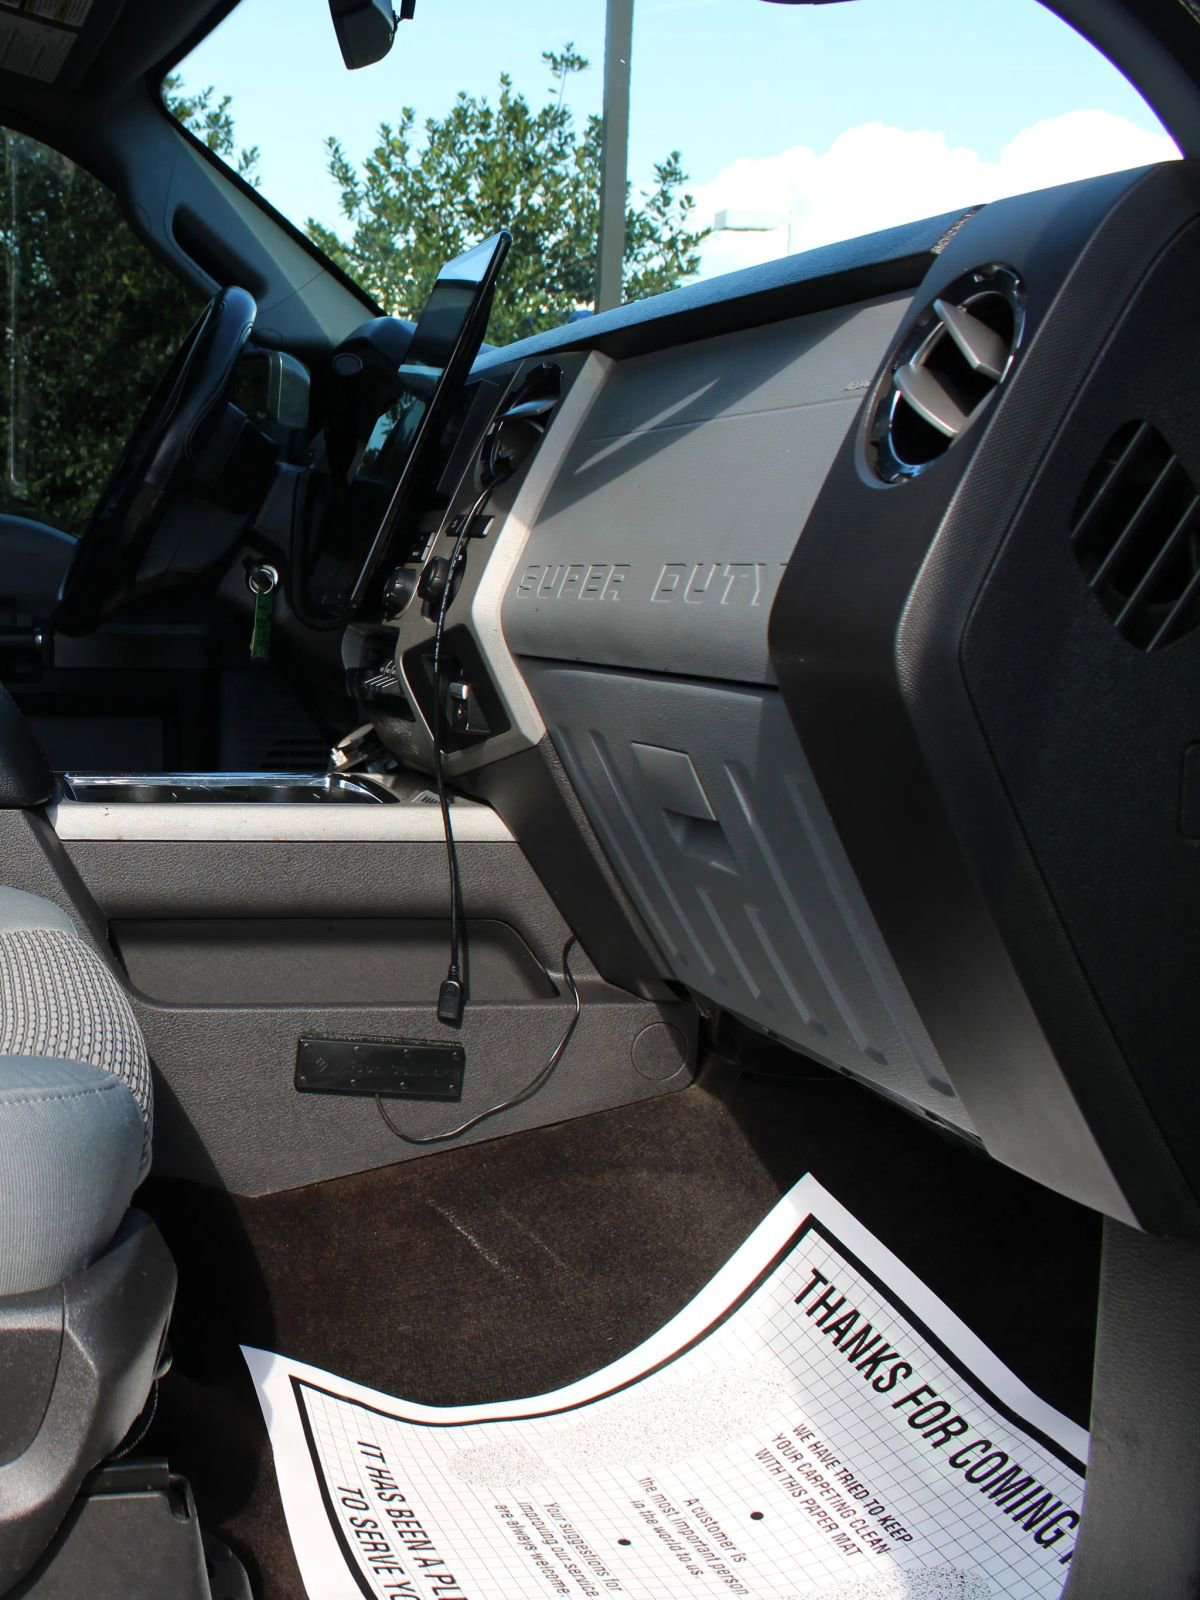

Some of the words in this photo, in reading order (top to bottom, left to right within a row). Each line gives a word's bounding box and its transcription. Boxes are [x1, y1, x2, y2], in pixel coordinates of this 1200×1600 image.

[516, 563, 632, 601] SUPER
[650, 562, 788, 607] DUTY
[794, 1267, 913, 1394] THANKS
[892, 1384, 969, 1450] FOR
[948, 1439, 1080, 1550] COMING
[356, 1440, 386, 1464] IT
[337, 1486, 370, 1511] TO
[365, 1465, 406, 1502] HAS
[683, 1498, 700, 1507] A
[754, 1447, 787, 1476] WITH
[779, 1474, 808, 1499] THIS
[799, 1497, 839, 1533] PAPER
[830, 1531, 863, 1557] MAT
[771, 1432, 804, 1464] YOUR
[796, 1462, 857, 1519] CARPETING
[849, 1518, 892, 1555] CLEAN
[792, 1423, 816, 1443] WE
[807, 1440, 841, 1470] HAVE
[833, 1467, 870, 1501] TRIED
[863, 1498, 885, 1516] TO
[876, 1514, 913, 1543] KEEP
[349, 1516, 405, 1575] SERVE
[385, 1508, 437, 1551] BEEN
[494, 1503, 514, 1519] are
[505, 1519, 538, 1553] always
[518, 1501, 559, 1546] improving
[551, 1545, 572, 1563] our
[564, 1562, 600, 1598] service
[543, 1501, 567, 1523] Your
[559, 1523, 610, 1578] suggestions
[603, 1577, 623, 1592] for
[630, 1499, 645, 1509] in
[638, 1510, 658, 1526] the
[653, 1525, 682, 1552] world
[675, 1551, 692, 1563] to
[638, 1476, 658, 1493] the
[651, 1493, 680, 1518] most
[672, 1518, 722, 1562] important
[708, 1561, 749, 1596] person
[691, 1506, 737, 1552] customer
[413, 1556, 446, 1569] A
[730, 1551, 747, 1563] is
[424, 1574, 468, 1600] PL
